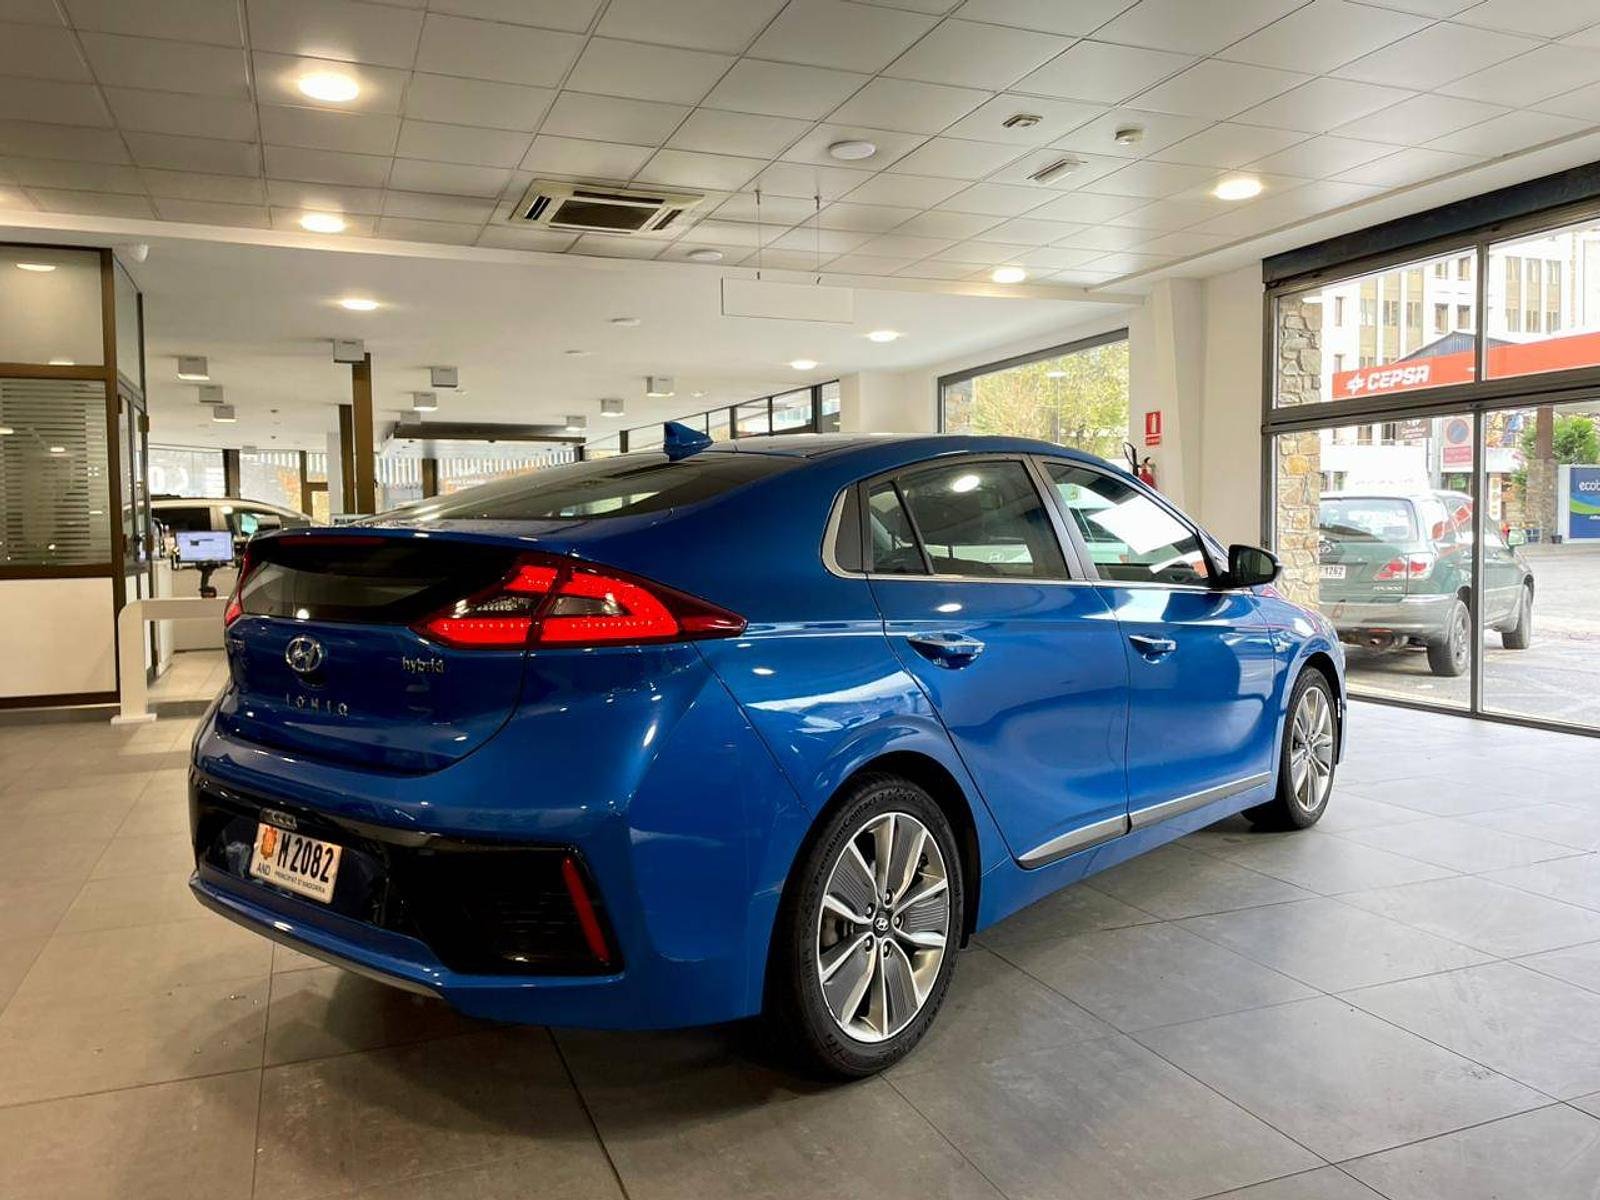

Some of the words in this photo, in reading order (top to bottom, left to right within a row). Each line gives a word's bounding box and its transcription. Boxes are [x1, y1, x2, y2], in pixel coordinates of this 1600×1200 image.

[1367, 364, 1430, 390] CEPSA
[402, 656, 445, 675] hybrid
[285, 691, 349, 718] IONIQ
[289, 837, 334, 883] 2082
